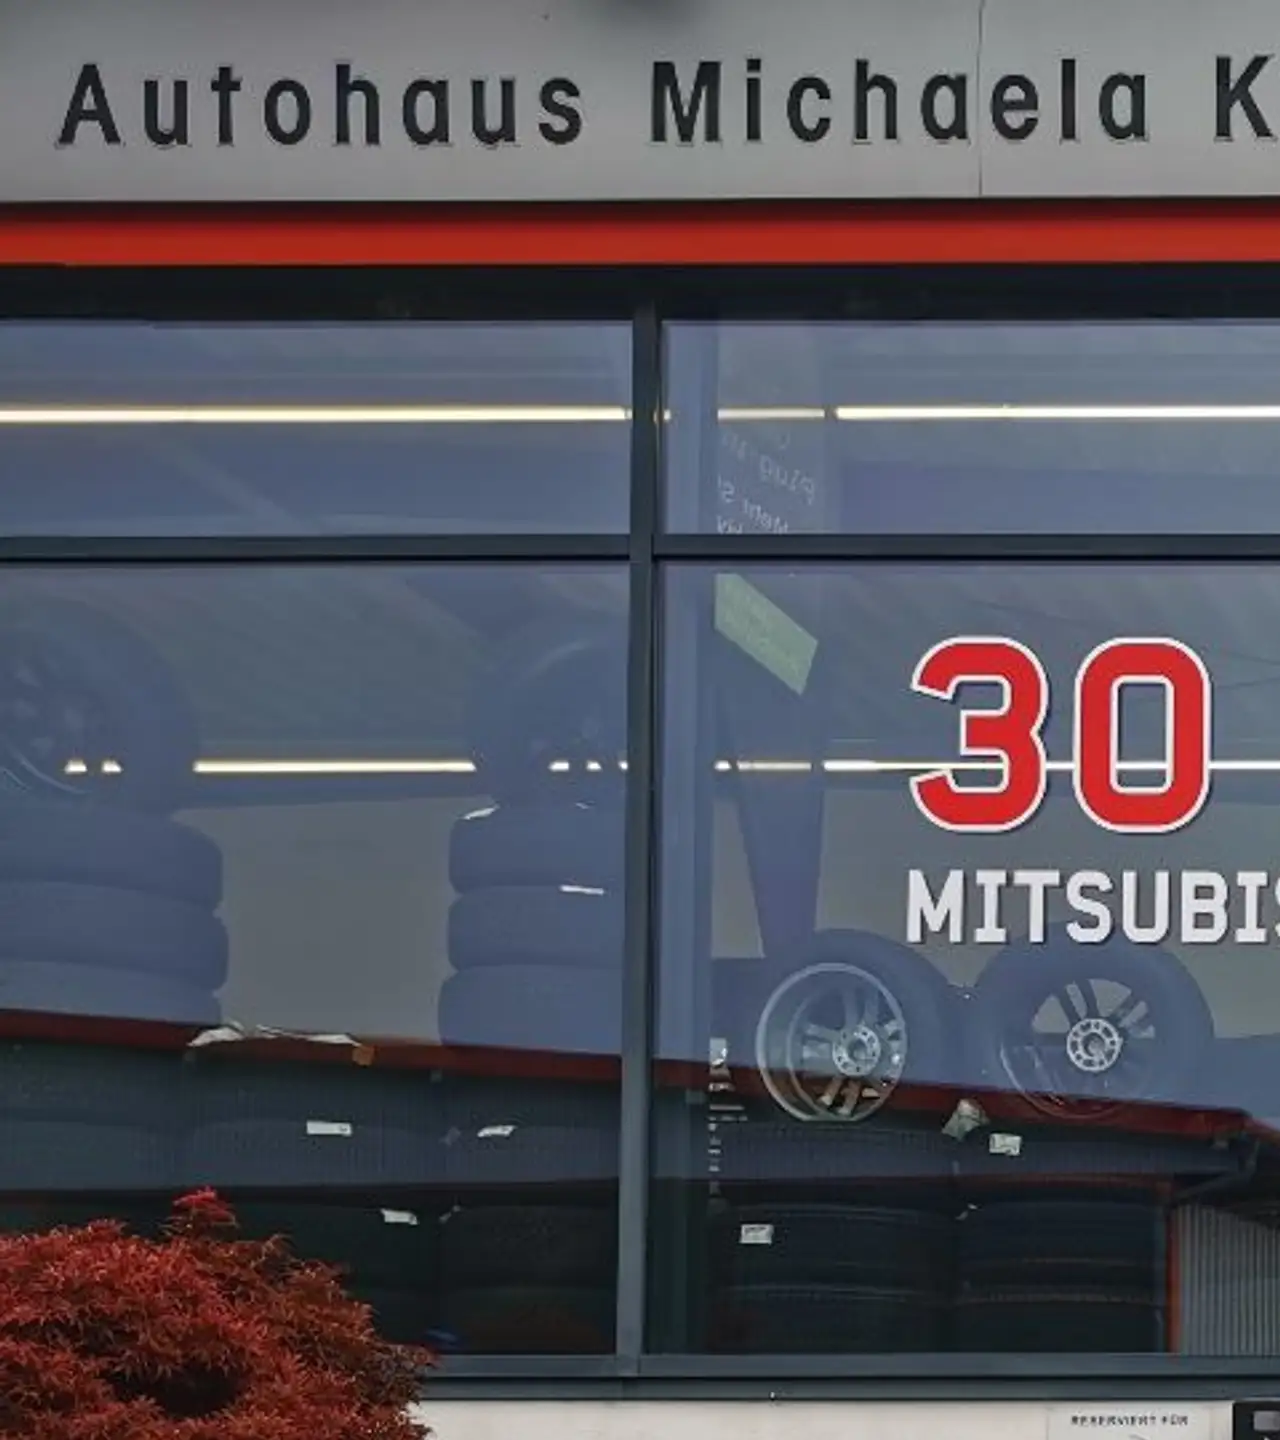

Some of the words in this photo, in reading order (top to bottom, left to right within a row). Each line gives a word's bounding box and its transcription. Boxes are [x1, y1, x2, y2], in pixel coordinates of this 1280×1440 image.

[57, 61, 583, 147] Autohaus
[648, 55, 1150, 144] Michaela
[909, 636, 1212, 834] 30
